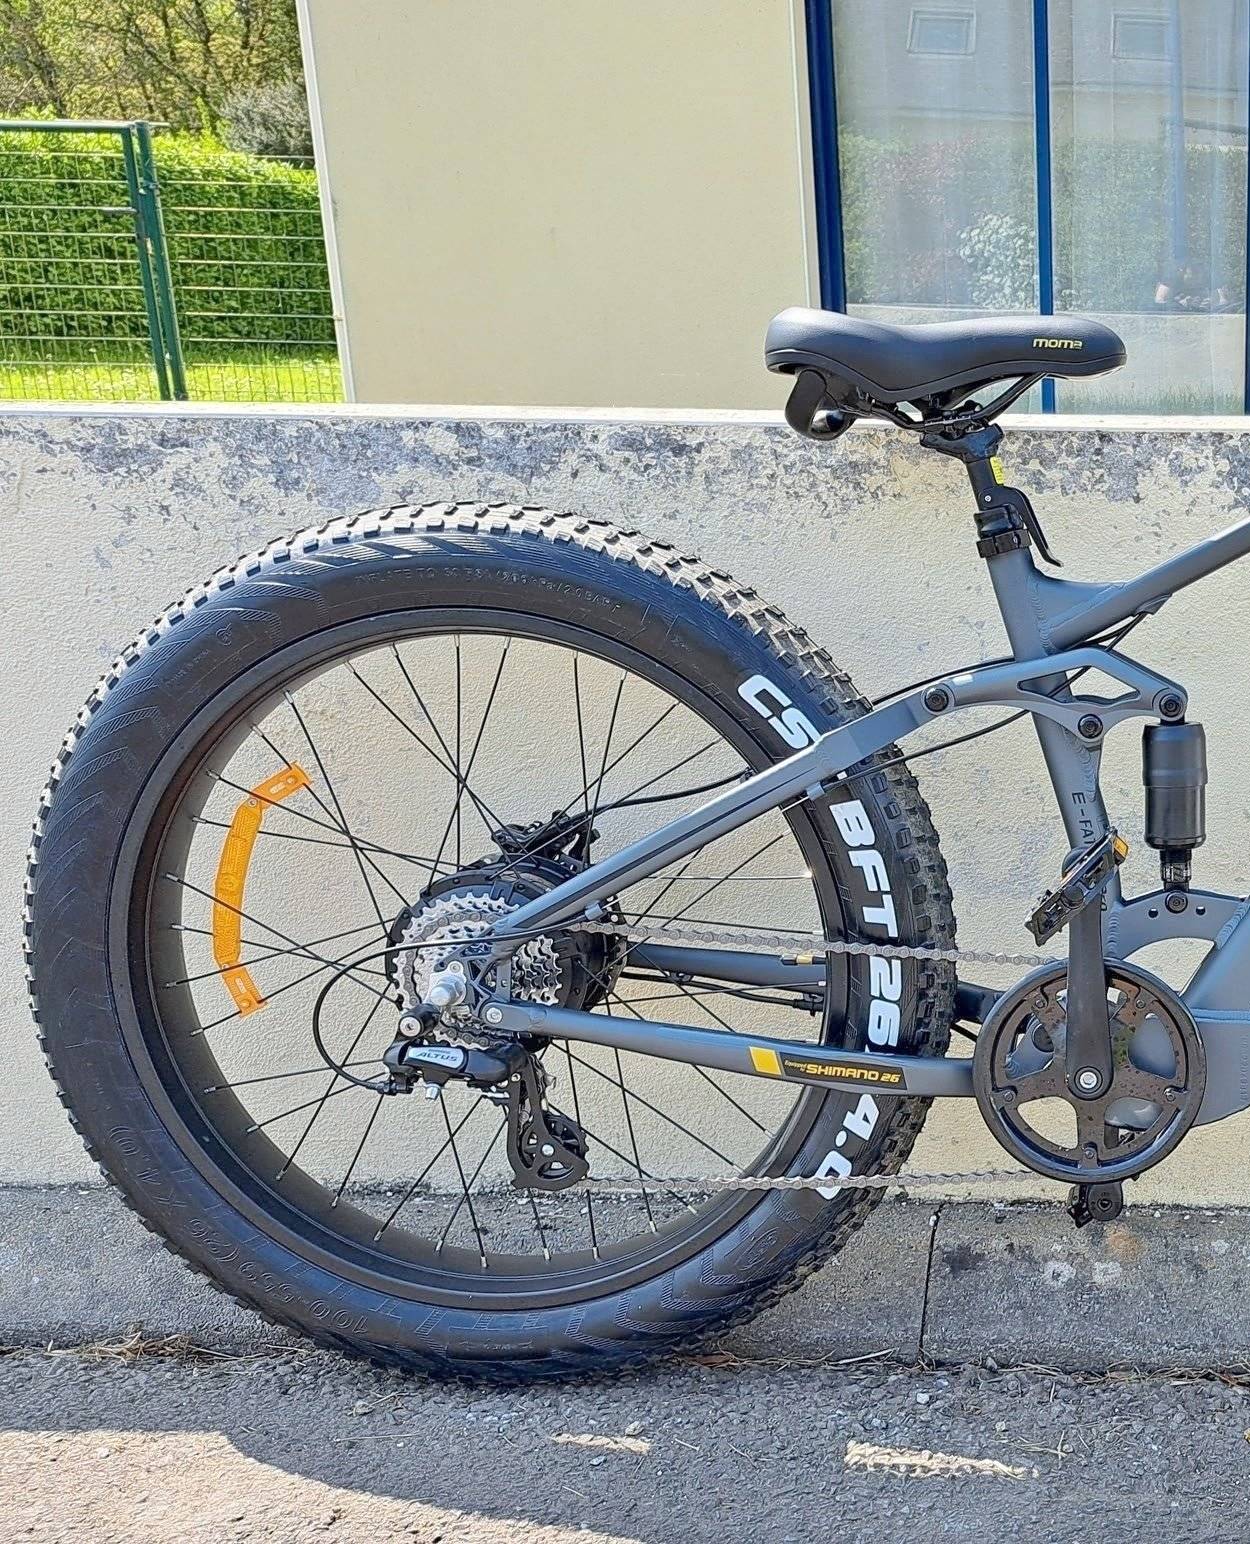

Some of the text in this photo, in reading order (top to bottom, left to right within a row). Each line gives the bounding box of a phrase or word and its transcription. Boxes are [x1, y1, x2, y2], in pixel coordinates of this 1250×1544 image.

[1032, 338, 1083, 350] moma
[828, 799, 900, 938] BFT
[416, 1051, 458, 1063] ALTUS
[805, 1063, 880, 1082] SHIMANO
